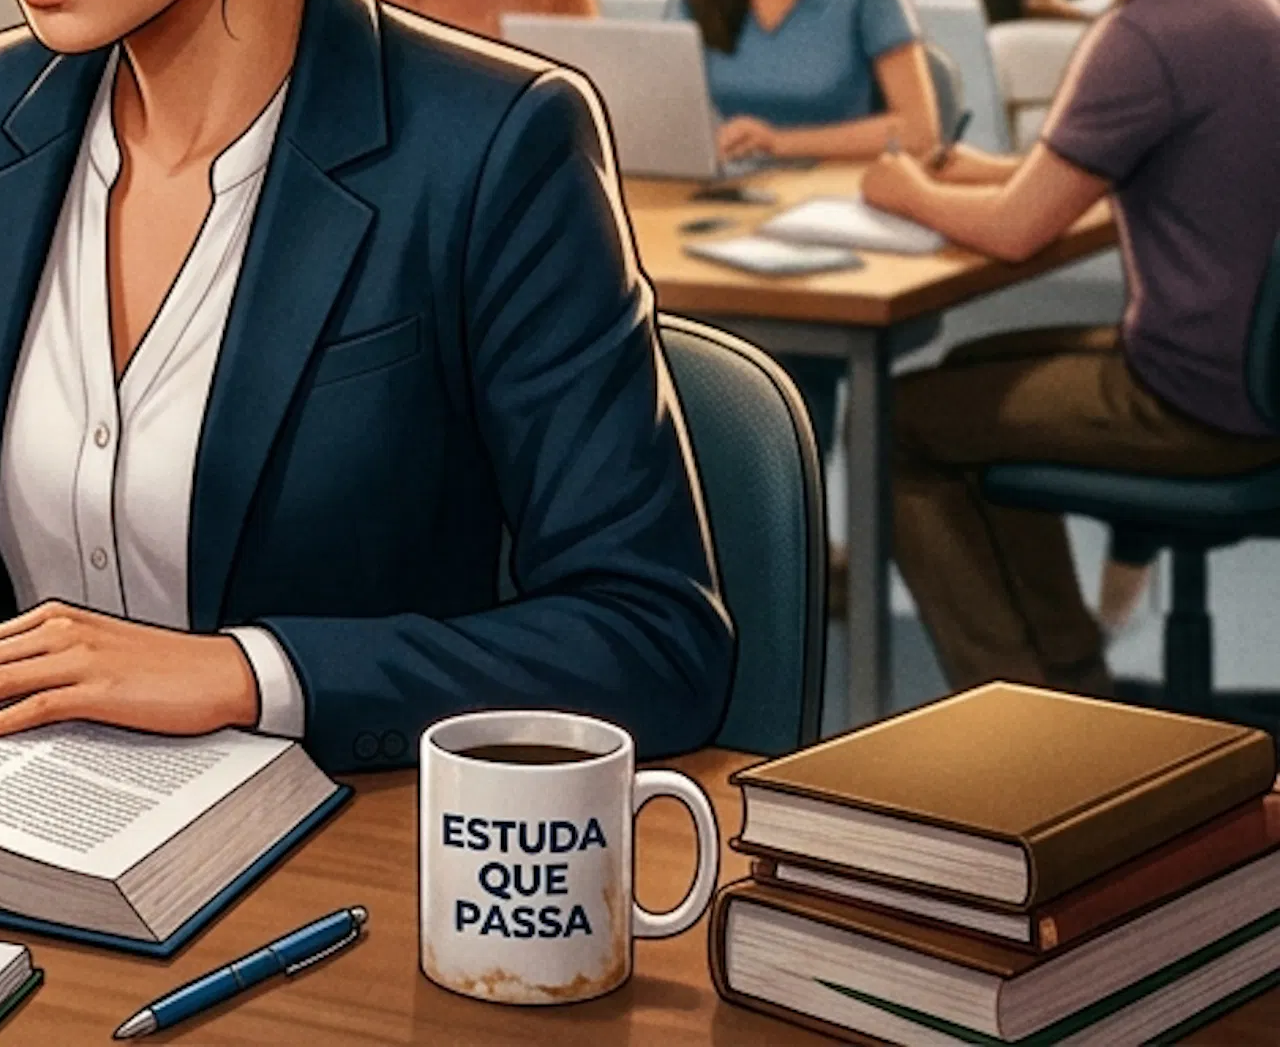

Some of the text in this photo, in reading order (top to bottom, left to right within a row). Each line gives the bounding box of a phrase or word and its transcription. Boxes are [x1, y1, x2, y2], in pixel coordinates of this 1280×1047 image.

[441, 814, 608, 854] ESTUDA
[478, 861, 569, 898] QUE
[454, 900, 593, 939] PASSA
